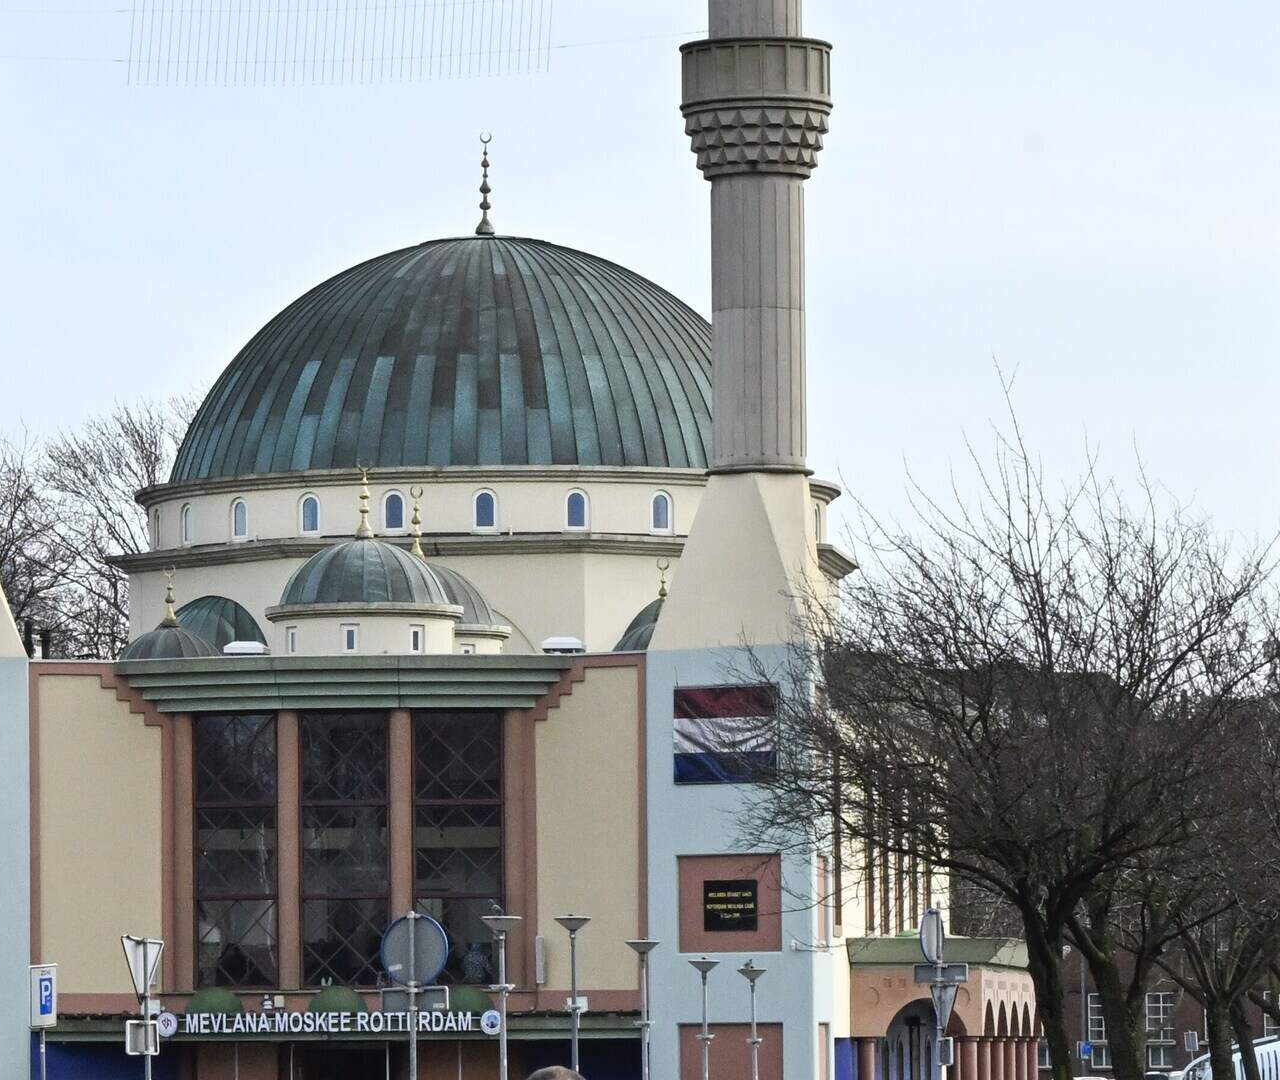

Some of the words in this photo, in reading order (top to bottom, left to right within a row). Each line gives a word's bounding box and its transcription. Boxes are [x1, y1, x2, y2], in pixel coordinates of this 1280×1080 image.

[41, 981, 51, 1005] P
[185, 1012, 270, 1033] MEVLANA
[275, 1011, 351, 1033] MOSKEE
[357, 1011, 472, 1032] ROTTERDAM
